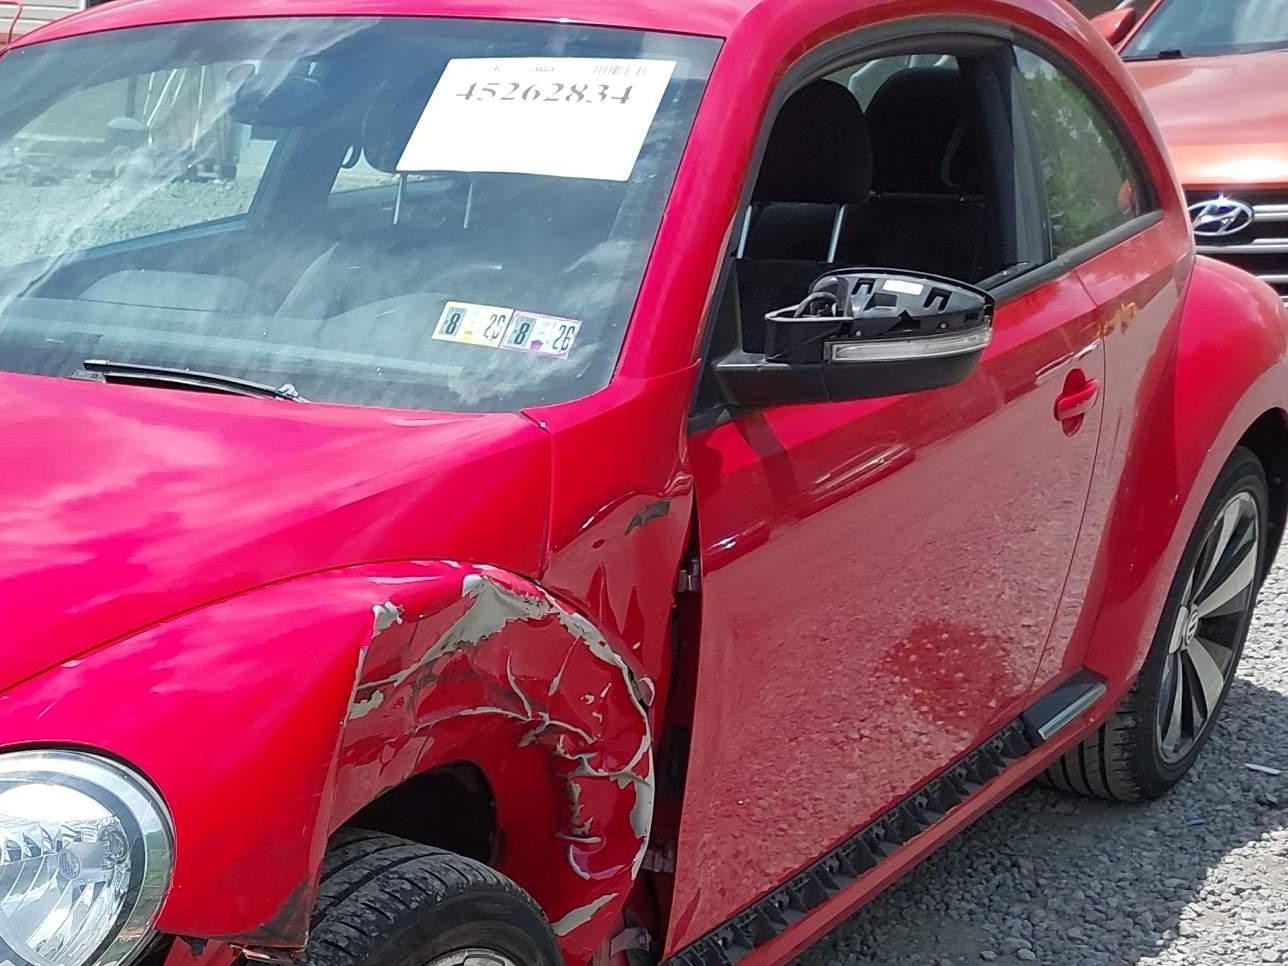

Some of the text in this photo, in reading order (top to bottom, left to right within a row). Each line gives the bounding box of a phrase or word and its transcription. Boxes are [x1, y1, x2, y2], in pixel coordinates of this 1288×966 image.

[456, 82, 633, 104] 45262834
[445, 313, 461, 335] 8
[513, 322, 576, 350] 8 26
